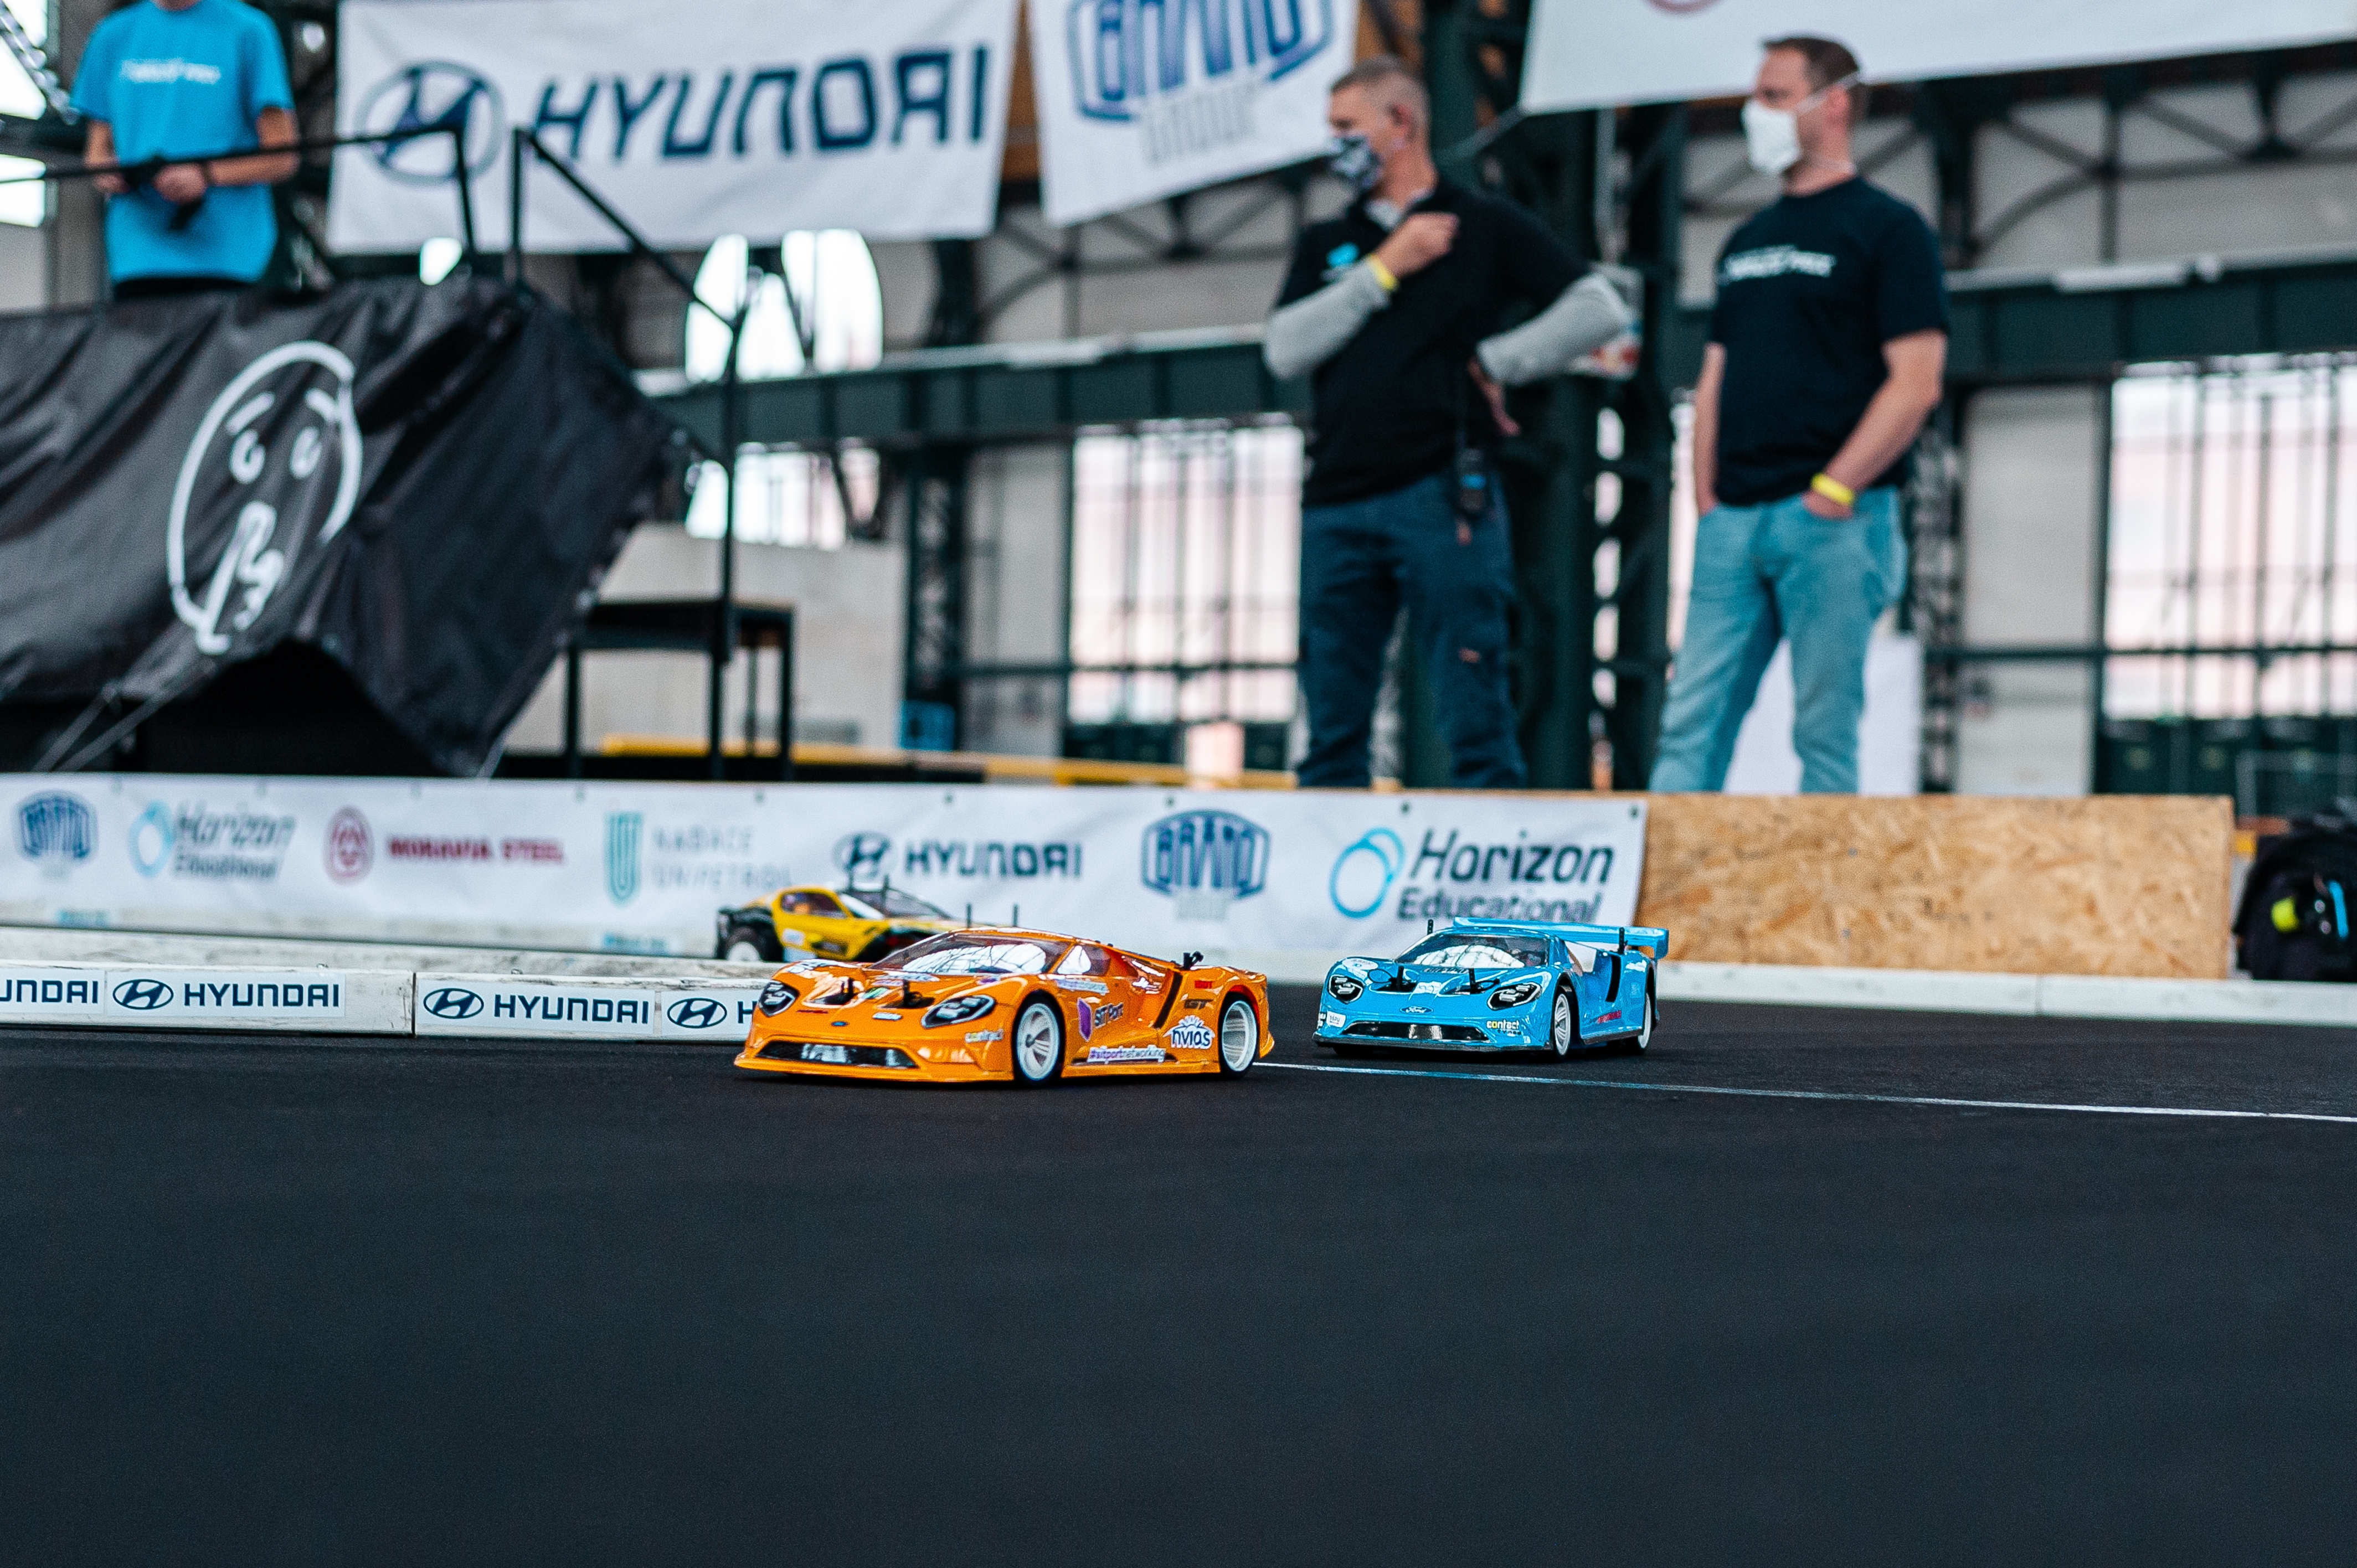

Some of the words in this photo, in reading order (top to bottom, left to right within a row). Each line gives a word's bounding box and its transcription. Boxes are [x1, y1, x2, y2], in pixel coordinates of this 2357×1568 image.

[533, 42, 989, 163] HYUNDAI
[905, 840, 1082, 879] HYUNDAI
[1409, 828, 1617, 884] Horizon
[1397, 887, 1602, 922] Educational
[184, 982, 339, 1008] HYUNDAI
[495, 994, 649, 1025] HYUNDAI
[1172, 1029, 1211, 1046] nvias
[1486, 1019, 1520, 1029] contact
